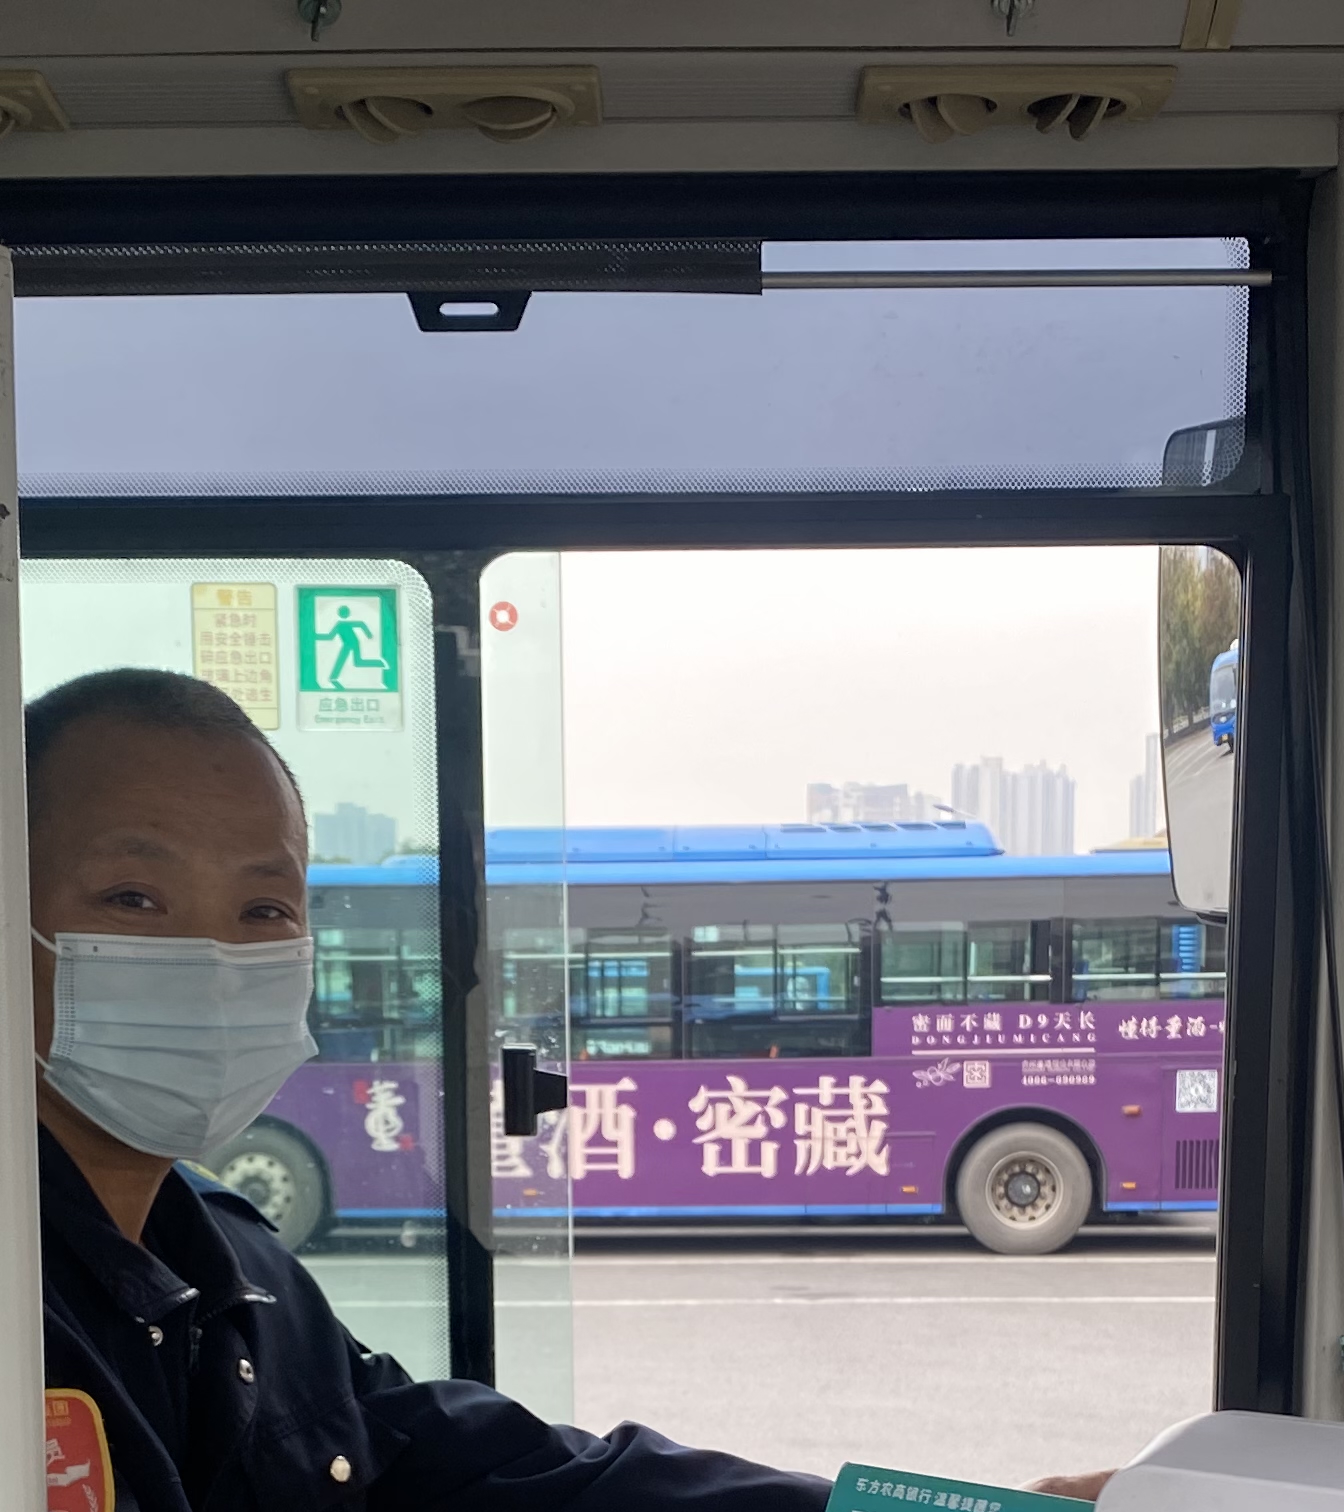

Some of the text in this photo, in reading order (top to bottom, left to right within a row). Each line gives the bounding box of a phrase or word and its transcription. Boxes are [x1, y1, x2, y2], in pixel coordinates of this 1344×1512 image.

[216, 589, 253, 606] 警告
[318, 697, 381, 712] 应急出口
[1018, 1010, 1097, 1031] D9天长
